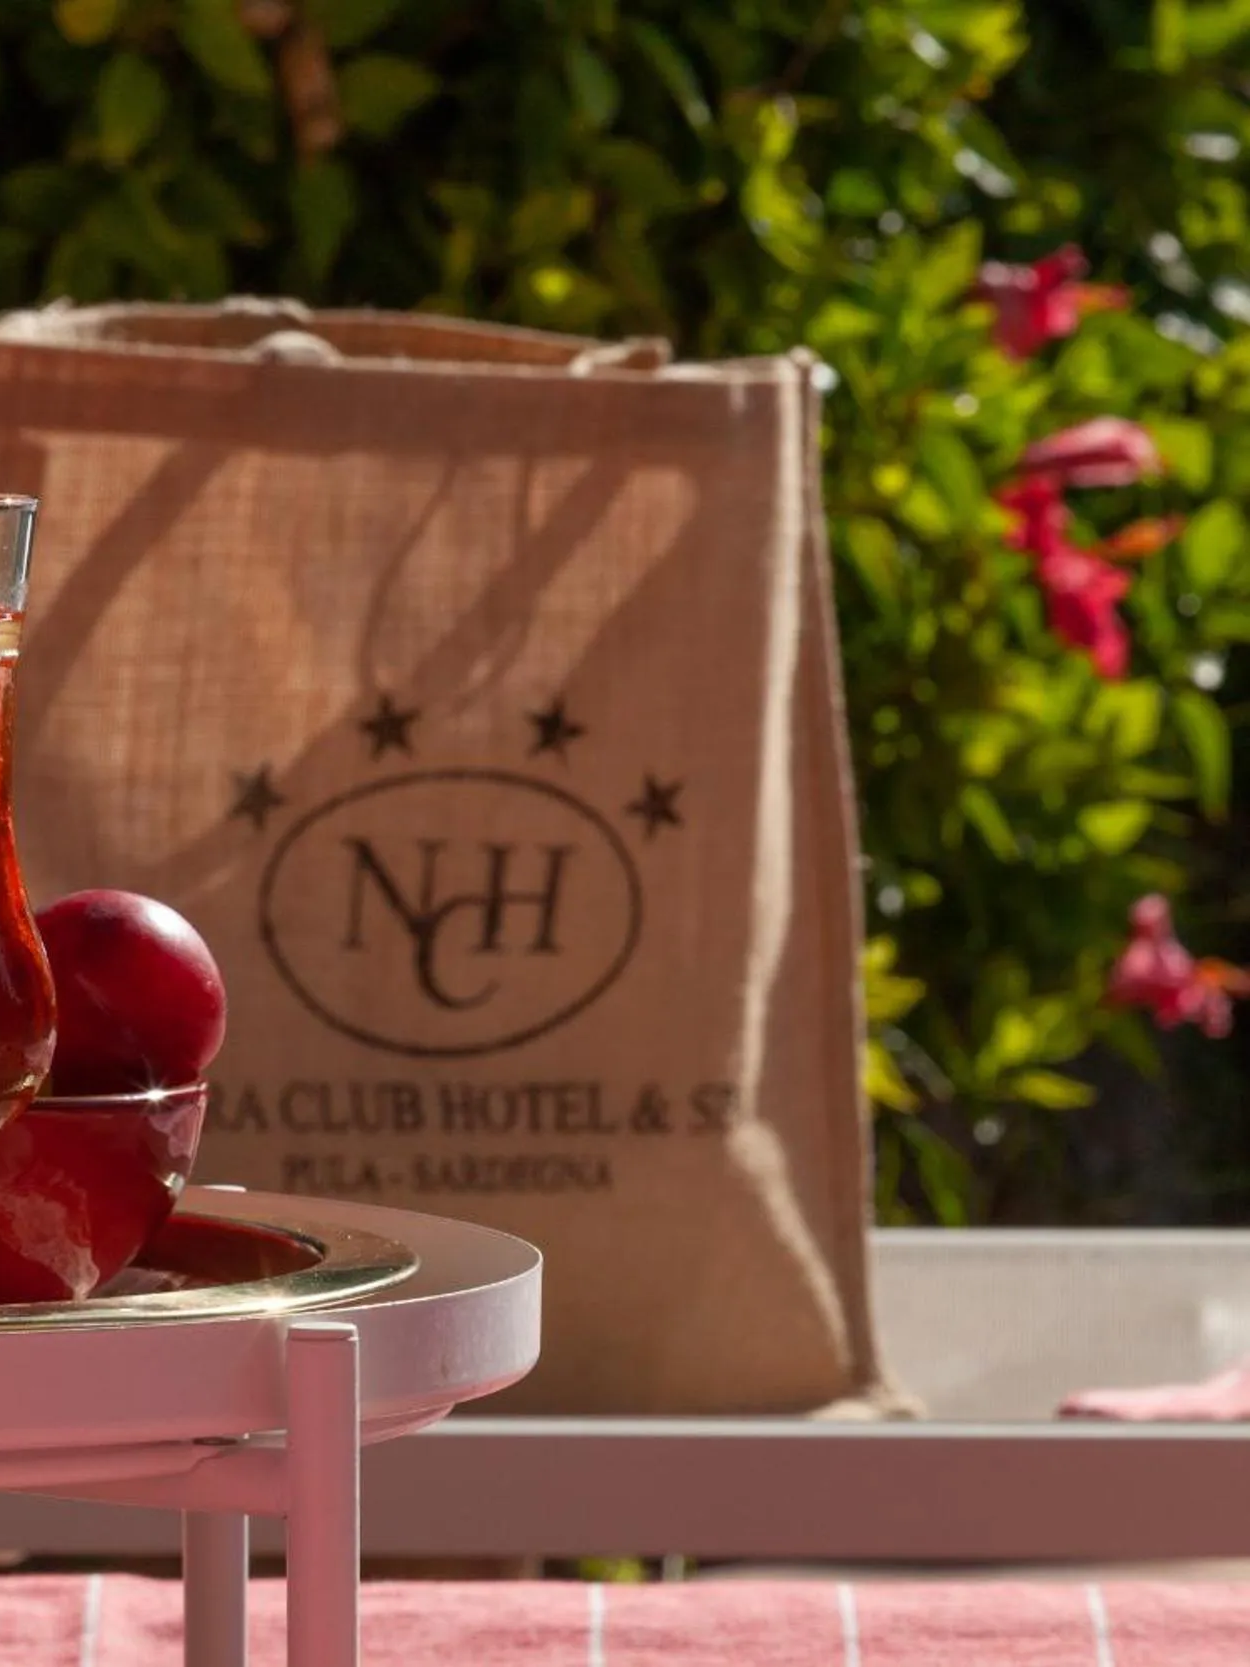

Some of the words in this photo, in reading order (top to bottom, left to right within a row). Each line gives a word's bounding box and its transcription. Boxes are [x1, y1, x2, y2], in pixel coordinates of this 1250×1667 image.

[204, 1081, 271, 1135] RA
[279, 1080, 428, 1135] CLUB
[438, 1080, 619, 1136] HOTEL
[629, 1080, 674, 1136] &
[282, 1155, 380, 1194] PULA
[410, 1155, 613, 1196] SARDEGNA
